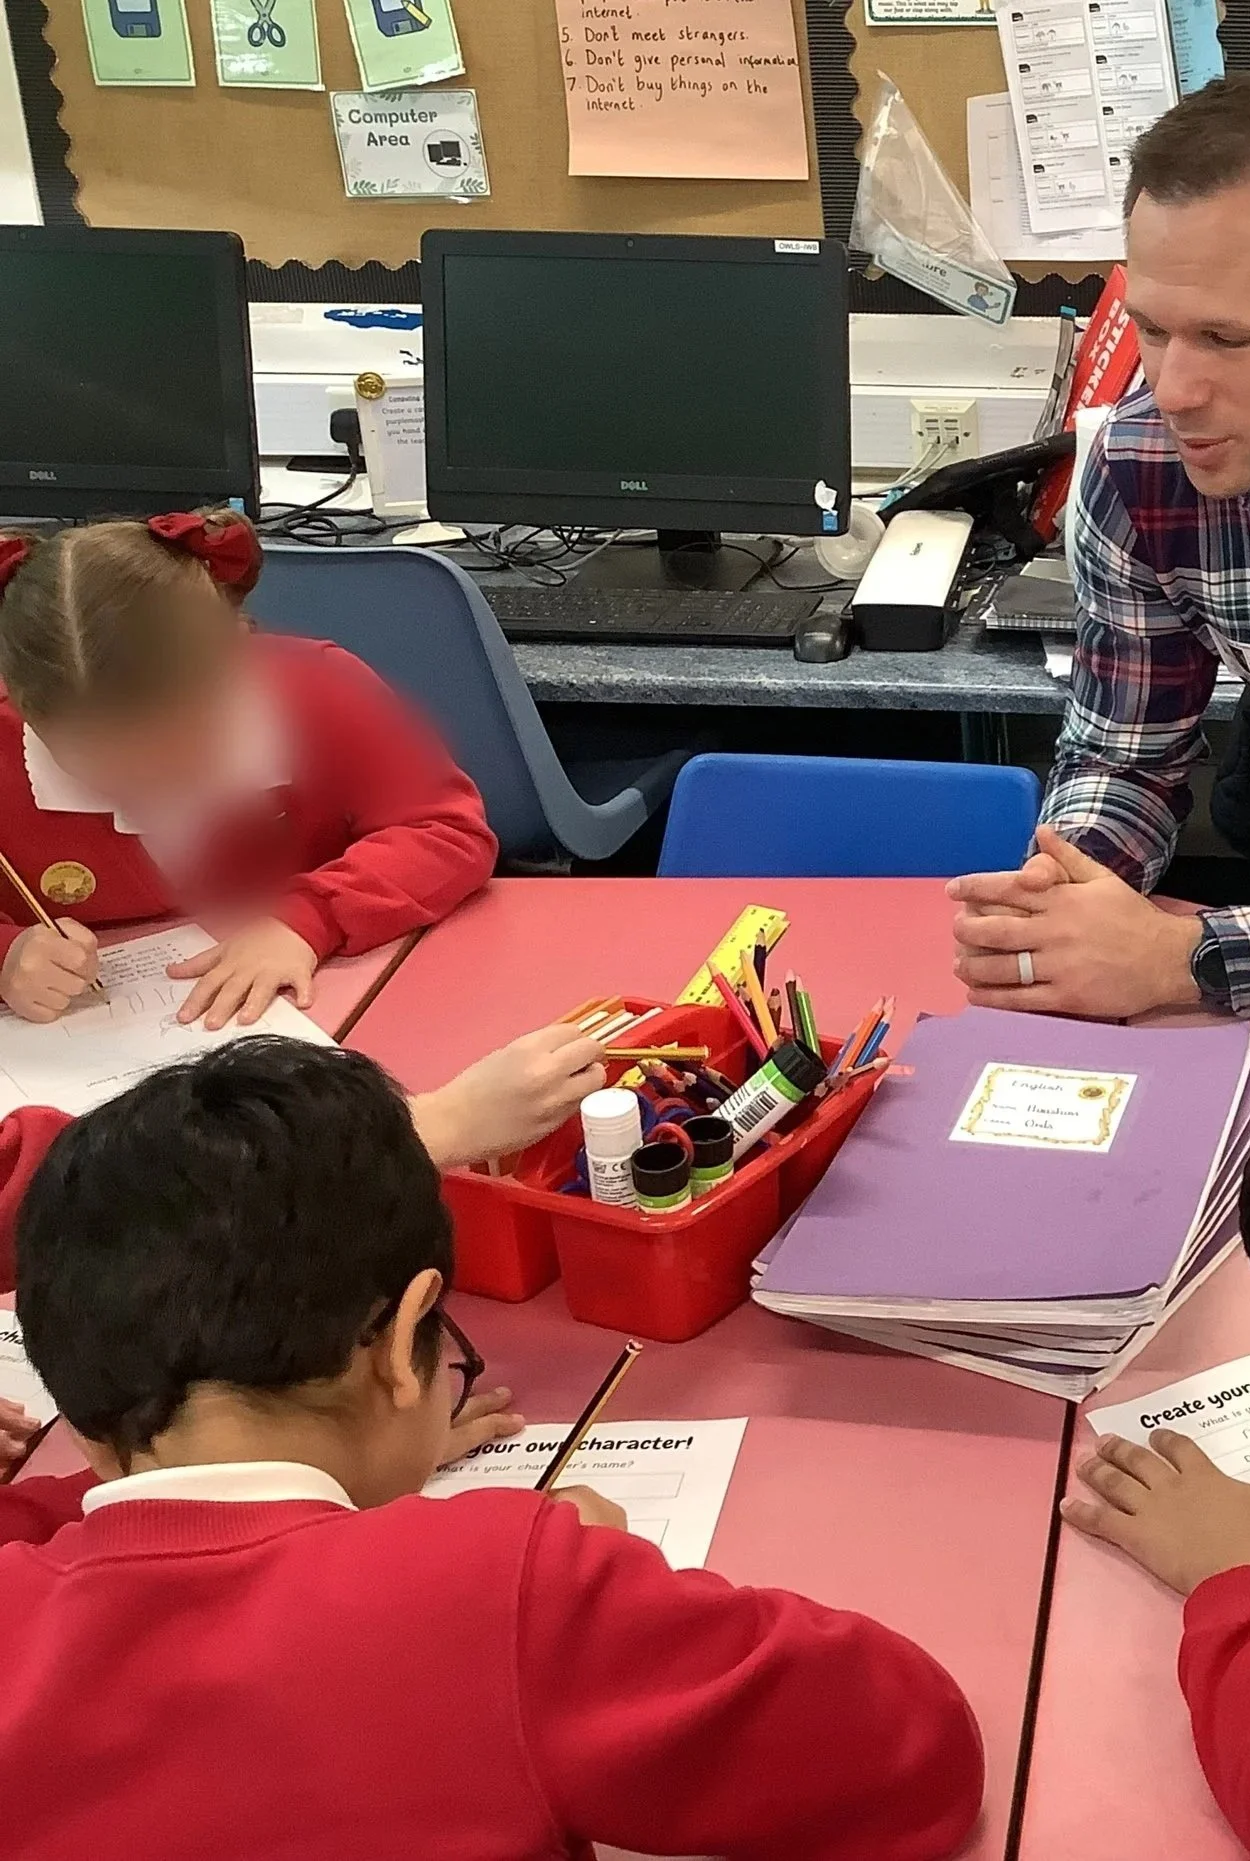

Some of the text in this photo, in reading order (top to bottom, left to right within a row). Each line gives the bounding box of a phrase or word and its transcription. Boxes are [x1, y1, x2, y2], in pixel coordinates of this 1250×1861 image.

[561, 26, 573, 43] 5.
[632, 28, 666, 41] meet
[679, 26, 749, 46] strangers.
[585, 49, 624, 67] Don't
[634, 55, 661, 73] give
[671, 52, 726, 72] personal
[585, 75, 625, 93] Don't
[636, 76, 668, 102] buy
[671, 74, 713, 98] things
[722, 81, 738, 91] on
[747, 79, 768, 94] the
[348, 108, 438, 127] Computer
[367, 131, 410, 146] Area
[1088, 297, 1121, 363] BOX
[29, 470, 57, 481] DELL
[620, 480, 649, 491] DELL
[1139, 1399, 1206, 1429] Create
[1207, 1383, 1250, 1409] your
[1199, 1414, 1229, 1429] What
[1234, 1409, 1243, 1419] is
[576, 1435, 694, 1451] character!
[484, 1465, 512, 1474] your
[592, 1460, 635, 1469] name?
